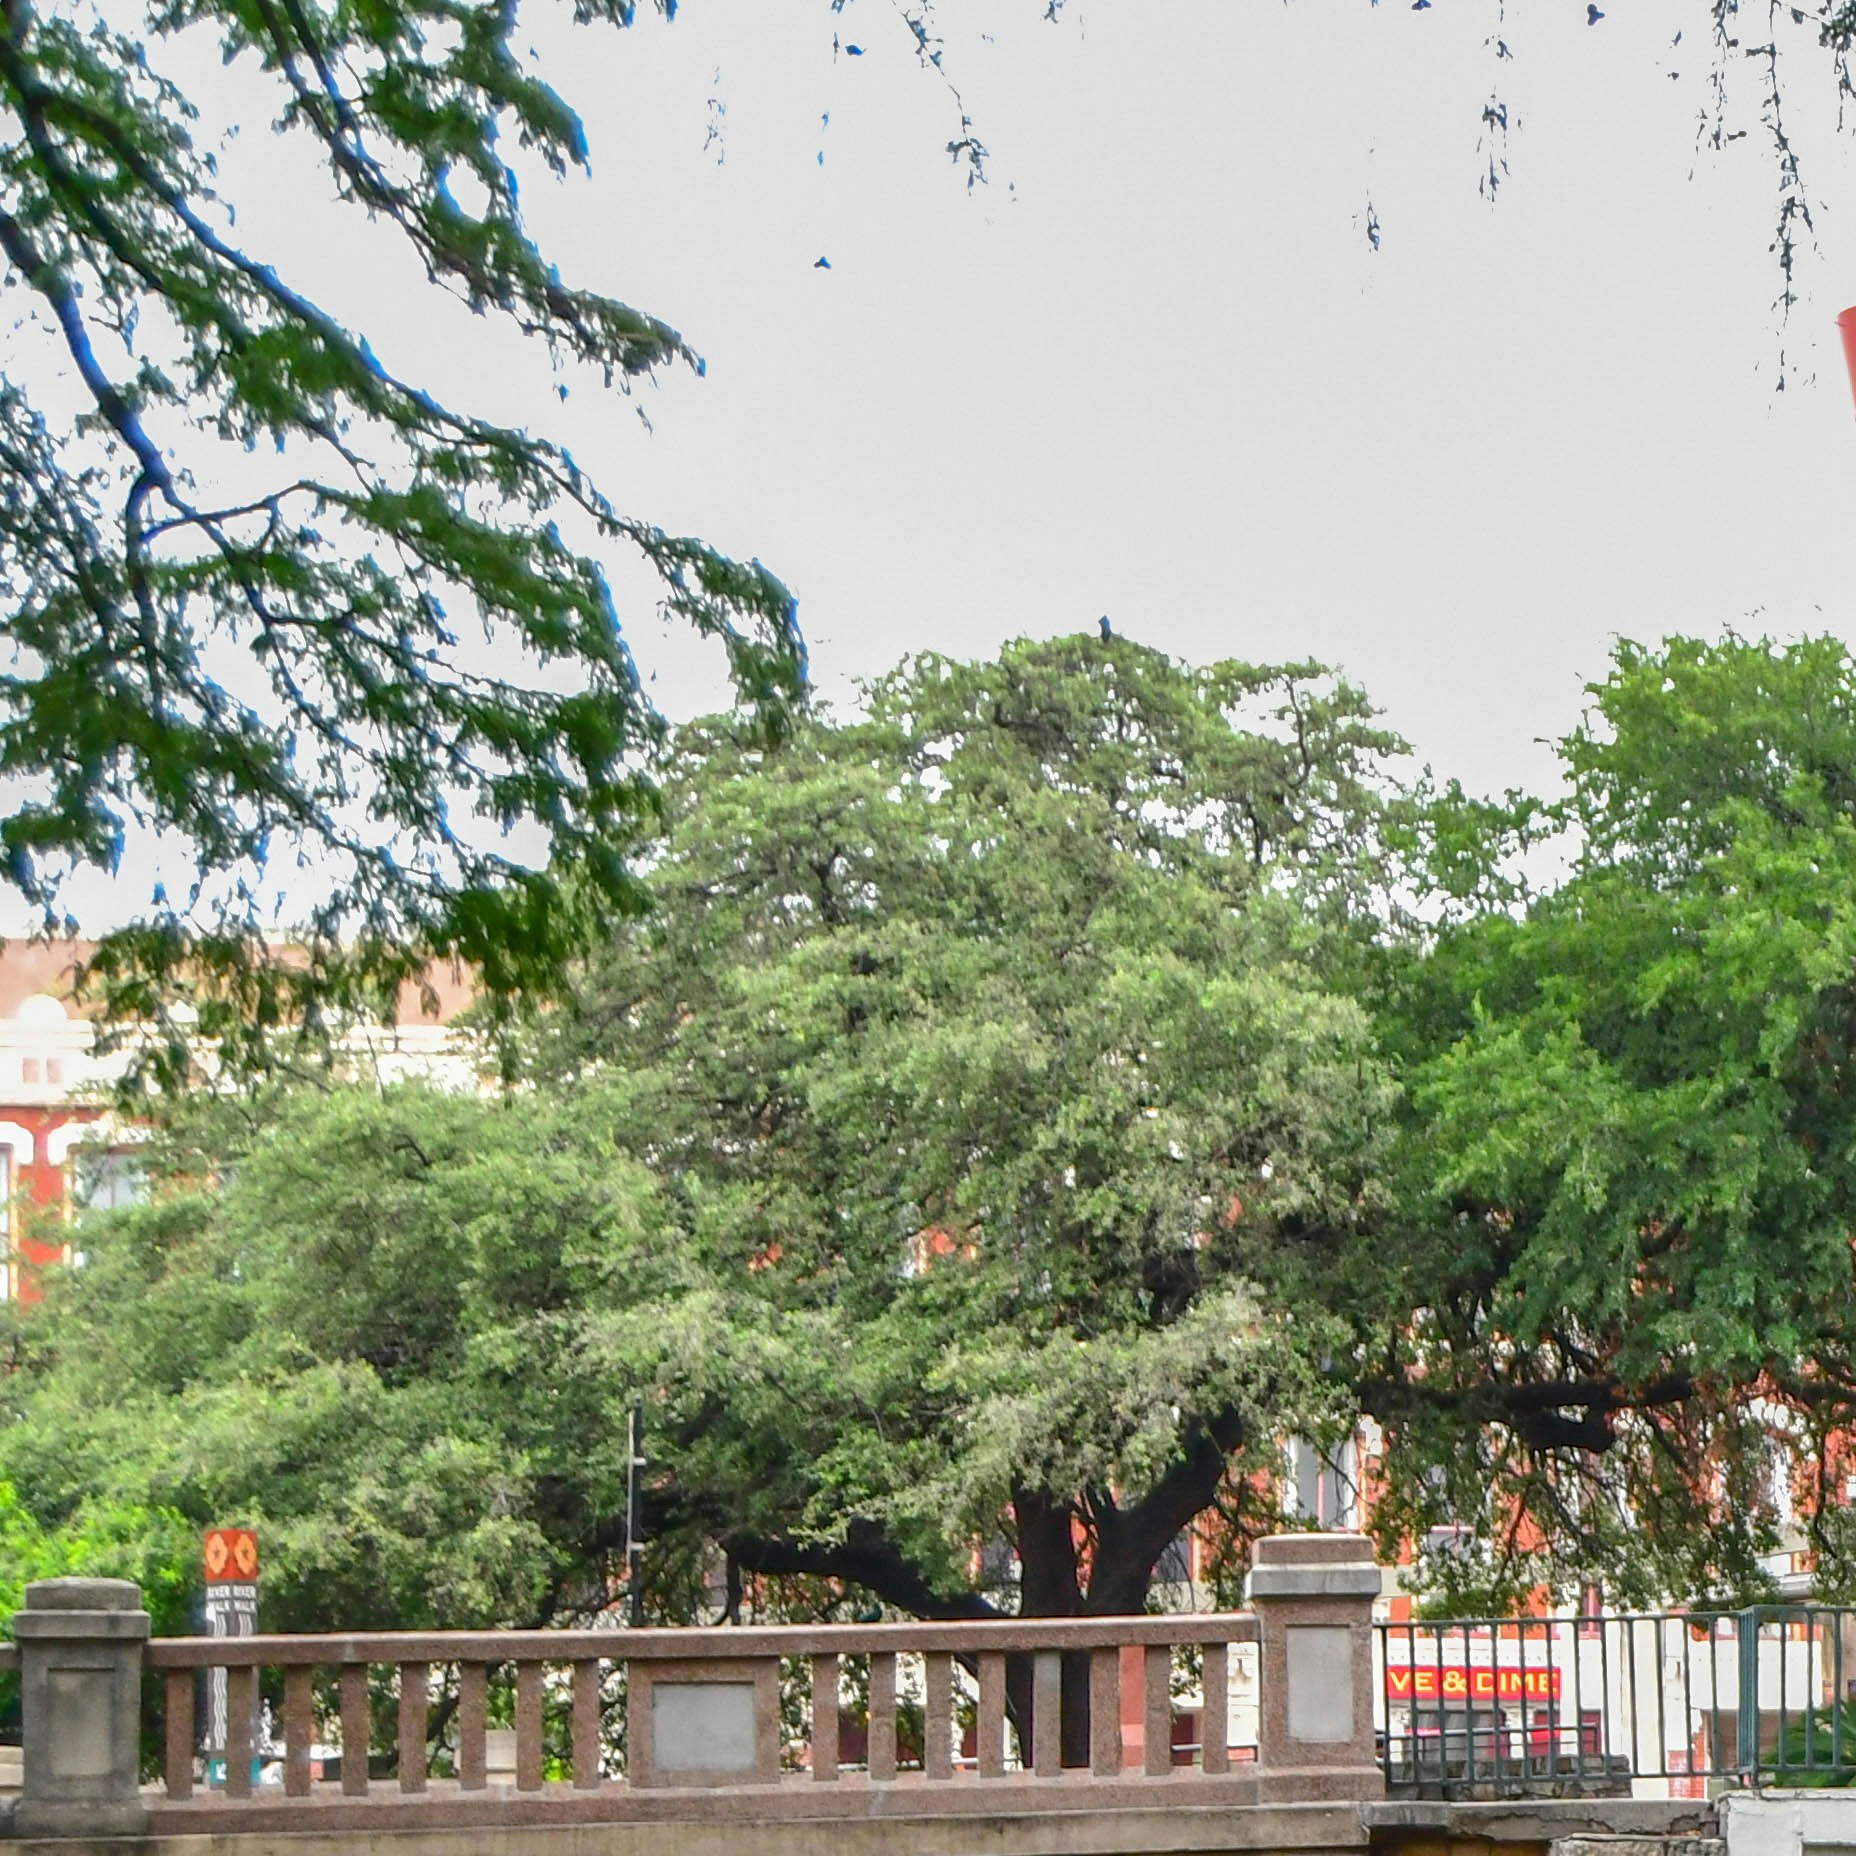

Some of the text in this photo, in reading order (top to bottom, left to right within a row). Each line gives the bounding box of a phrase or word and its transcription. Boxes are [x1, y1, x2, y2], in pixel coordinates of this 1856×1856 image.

[1389, 1670, 1557, 1692] VE & DIME
